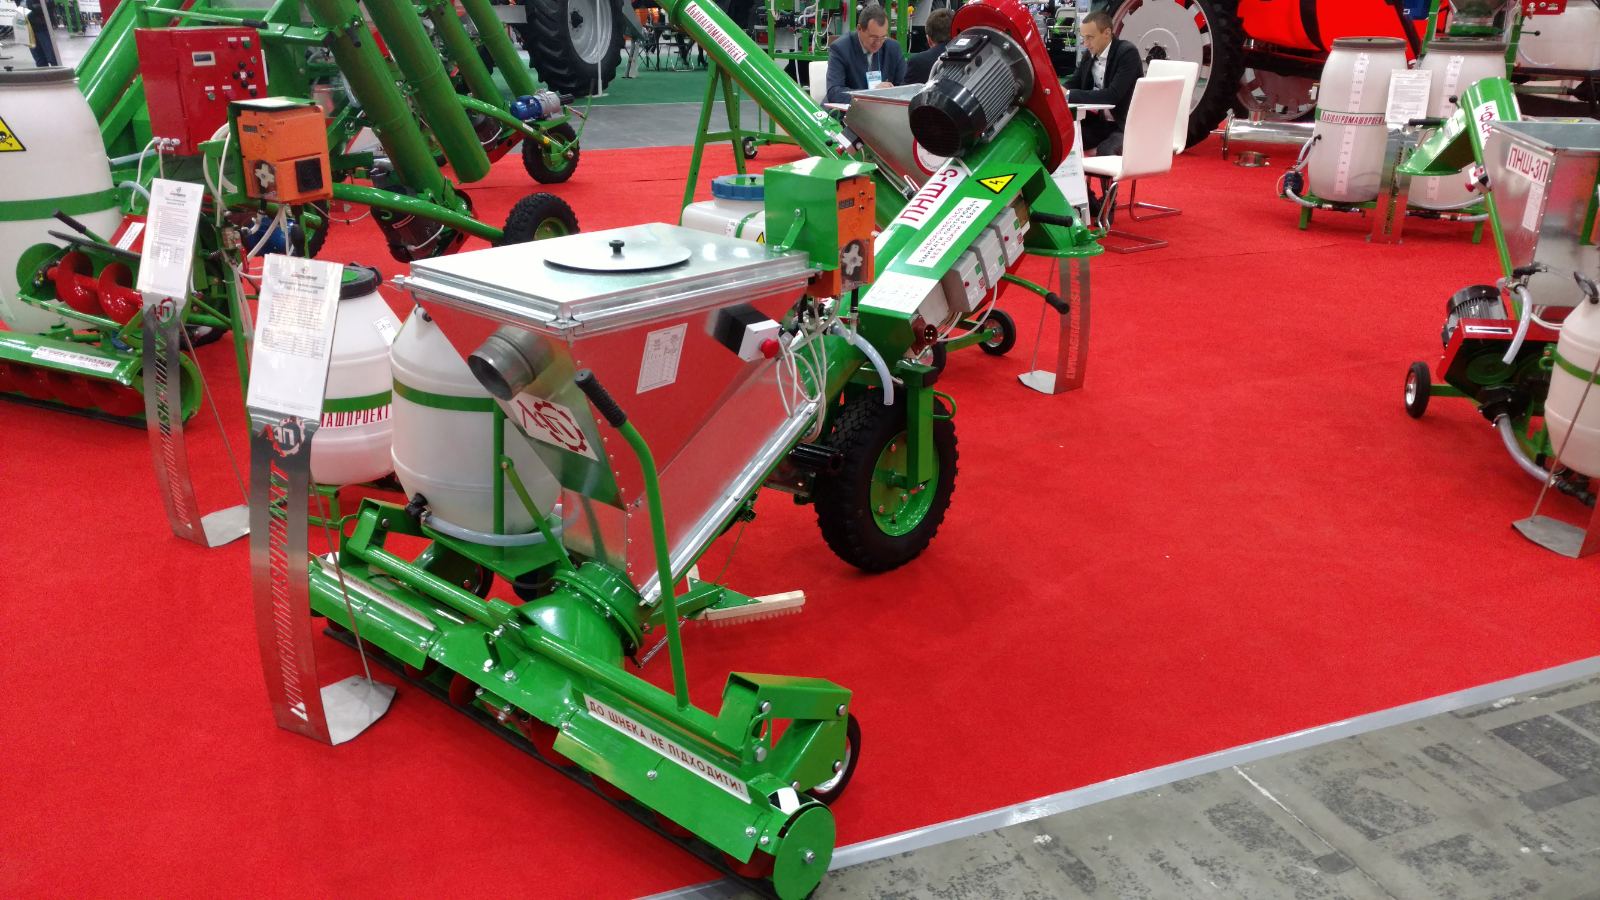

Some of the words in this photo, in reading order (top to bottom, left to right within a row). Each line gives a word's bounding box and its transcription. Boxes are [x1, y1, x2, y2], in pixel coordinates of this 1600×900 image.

[1508, 147, 1549, 183] ПНШ-3П
[899, 168, 959, 223] ПНШ-5
[589, 700, 605, 717] ДО
[607, 709, 647, 740] ШНЕКА
[651, 734, 665, 751] НЕ
[667, 743, 744, 795] ПІДХОДИТИ!
